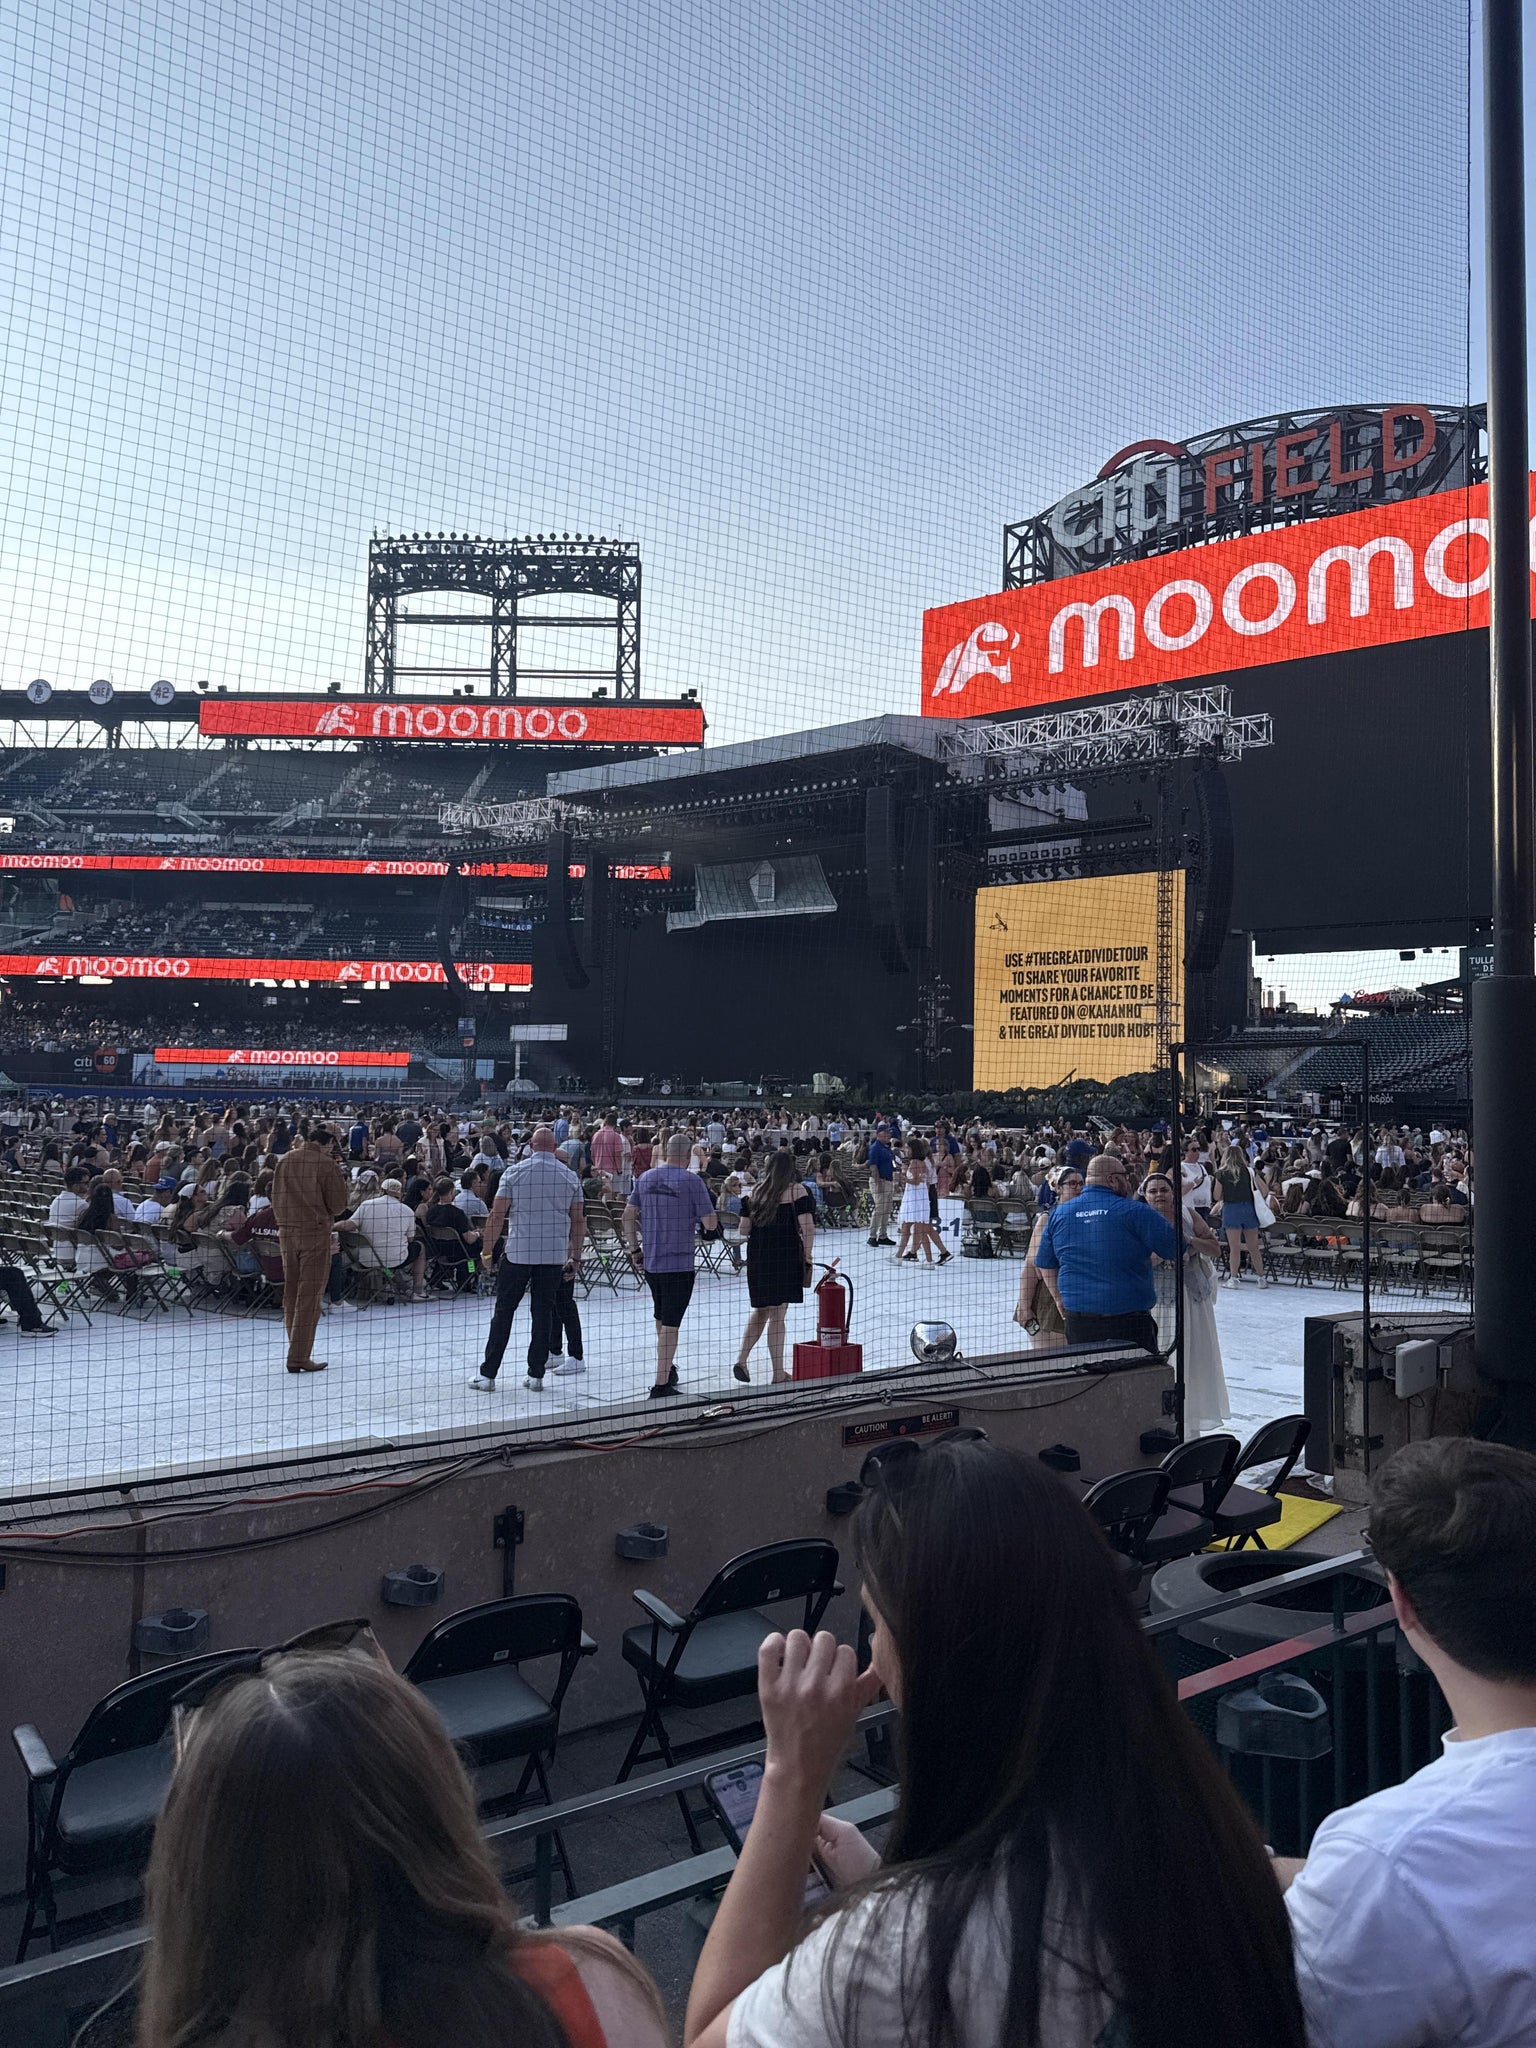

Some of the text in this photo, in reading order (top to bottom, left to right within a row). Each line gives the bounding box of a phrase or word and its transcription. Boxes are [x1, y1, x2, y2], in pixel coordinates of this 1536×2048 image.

[1051, 404, 1436, 548] citi FIELD
[1049, 515, 1536, 675] moomo
[153, 687, 170, 699] 42
[372, 705, 588, 739] moomoo
[2, 855, 84, 869] moomoo
[180, 857, 264, 871] moomoo
[1005, 946, 1148, 967] USE #THEGREATDIVIDETOUR
[67, 957, 190, 976] moomoo
[1012, 966, 1140, 985] TO SHARE YOUR FAVORITE
[1000, 984, 1154, 1003] MOMENTS FOR A CHANCE TO BE
[1010, 1006, 1058, 1021] FEATURED
[1061, 1005, 1075, 1020] ON
[999, 1025, 1006, 1039] &
[1008, 1025, 1026, 1039] THE
[1028, 1024, 1059, 1039] GREAT
[1061, 1024, 1095, 1038] DIVIDE
[1097, 1023, 1125, 1038] TOUR
[74, 1056, 92, 1067] citi
[103, 1056, 115, 1065] 60
[250, 1050, 338, 1064] moomoo
[1075, 1210, 1109, 1218] SECURITY
[922, 1411, 953, 1424] BE ALERT!
[854, 1422, 888, 1435] CAUTION!
